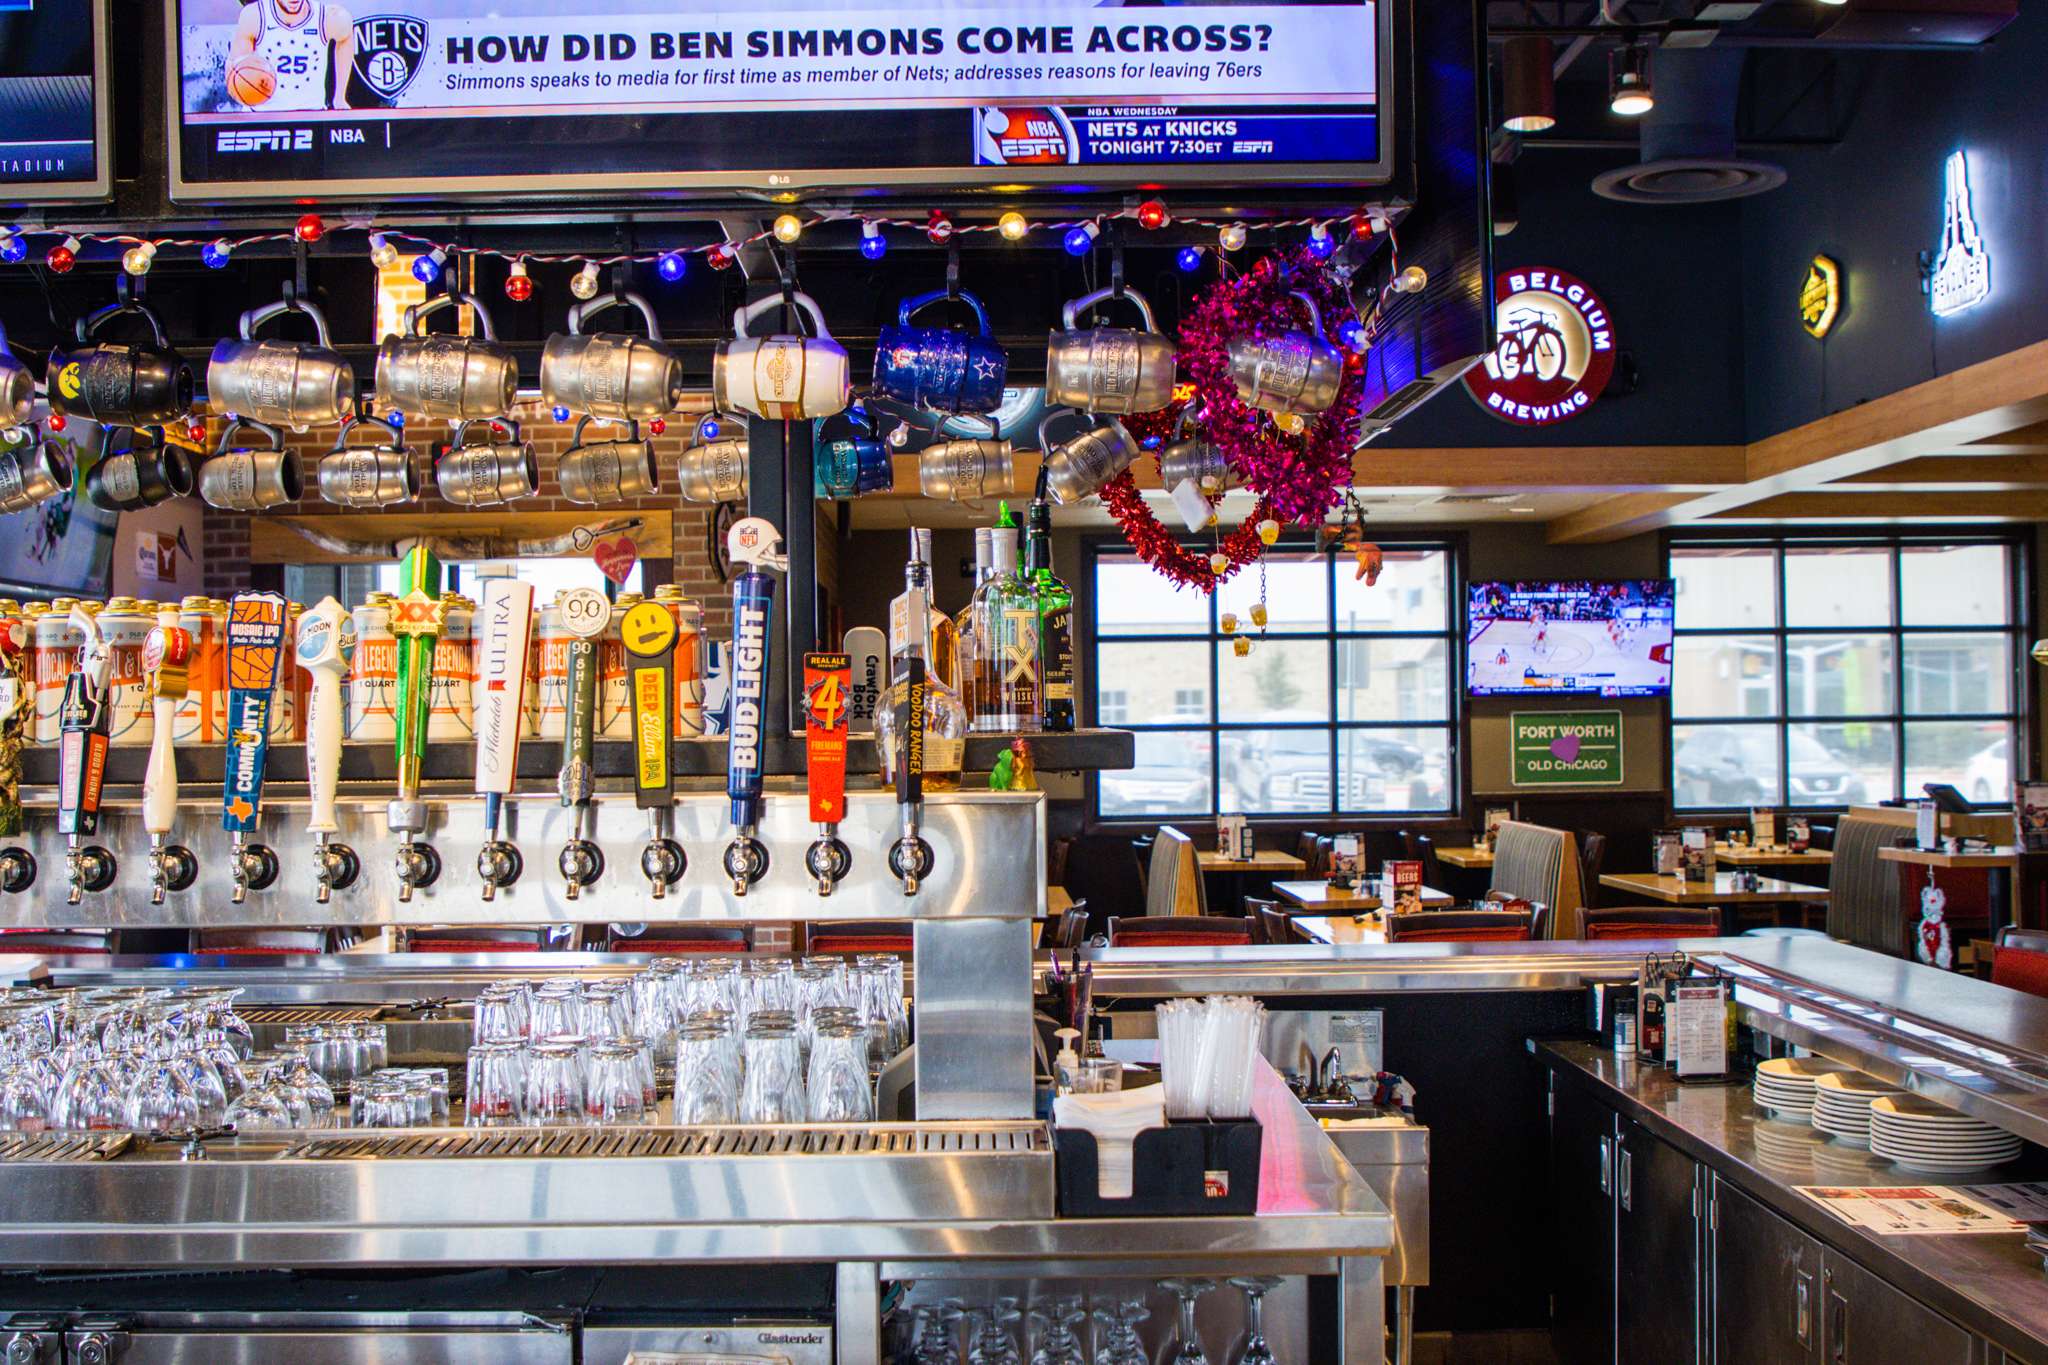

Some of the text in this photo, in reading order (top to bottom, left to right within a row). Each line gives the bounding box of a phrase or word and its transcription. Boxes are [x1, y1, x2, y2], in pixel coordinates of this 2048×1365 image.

[354, 20, 422, 54] NETS
[446, 24, 1273, 64] HOW DID BEN SIMMONS COME ACROSS?
[277, 55, 308, 74] 25
[382, 57, 395, 85] B
[446, 61, 1263, 92] Simmons speaks to media for first time as member of Nets; addresses reasons for leaving 76ers
[1088, 107, 1178, 116] NBA WEDNESDAY
[330, 129, 365, 143] NBA
[1027, 120, 1060, 137] NBA
[1088, 121, 1237, 137] NETS AT KNICKS
[1001, 138, 1067, 157] ESPN
[1089, 141, 1165, 155] TONIGHT
[1232, 141, 1273, 153] ESPN
[1, 159, 65, 173] TADIUM
[1509, 271, 1612, 351] BELGIUM
[1487, 391, 1590, 420] BREWING
[741, 534, 756, 546] NFL
[397, 602, 438, 622] XX
[568, 599, 600, 619] 90
[231, 624, 279, 636] MOSAIC IPA
[490, 595, 511, 674] ULTRA
[572, 642, 591, 655] 90
[736, 605, 764, 699] LIGHT
[811, 656, 846, 665] REAL ALE
[365, 680, 395, 688] QUART
[432, 680, 461, 688] QUART
[643, 673, 659, 711] DEEP
[573, 658, 586, 750] SHILLING
[814, 674, 840, 731] 4
[853, 684, 867, 720] Bock
[910, 683, 924, 729] VOODOO
[485, 696, 502, 774] Michelob
[640, 712, 661, 758] Ellum
[733, 702, 759, 769] BUD
[1519, 725, 1615, 738] FORT WORTH
[93, 743, 103, 769] BLOOD
[236, 696, 264, 793] COMMUNITY
[909, 730, 923, 775] RANGER
[645, 759, 661, 781] IPA
[1527, 759, 1608, 771] OLD CHICAGO
[88, 775, 98, 802] HONEY
[309, 756, 319, 801] WHITE
[757, 1332, 825, 1345] Glastender
